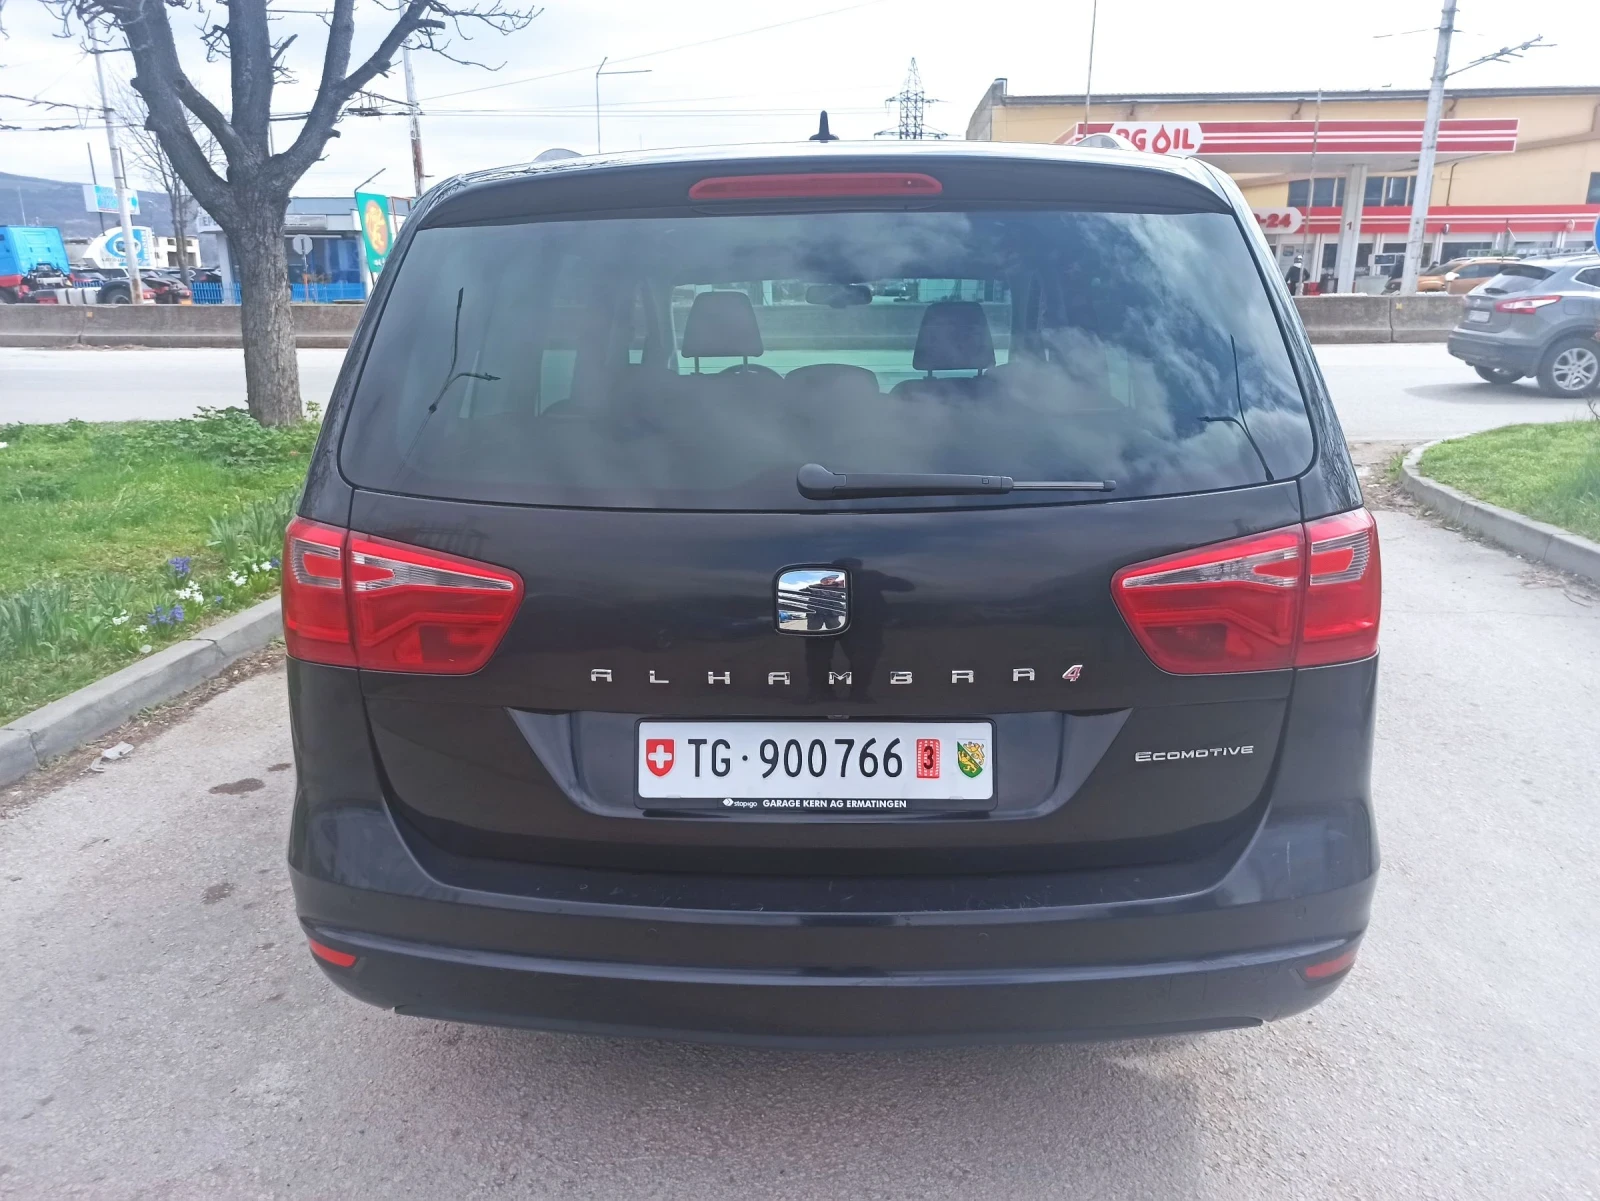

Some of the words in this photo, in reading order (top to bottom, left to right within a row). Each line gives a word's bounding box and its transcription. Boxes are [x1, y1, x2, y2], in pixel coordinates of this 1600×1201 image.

[590, 667, 1035, 685] ALHAMBRA
[1062, 664, 1083, 683] 4
[923, 745, 934, 770] 3
[762, 799, 801, 808] GARAGE
[803, 799, 828, 808] KERN
[830, 799, 844, 808] AG
[846, 799, 907, 808] ERMATINGEN
